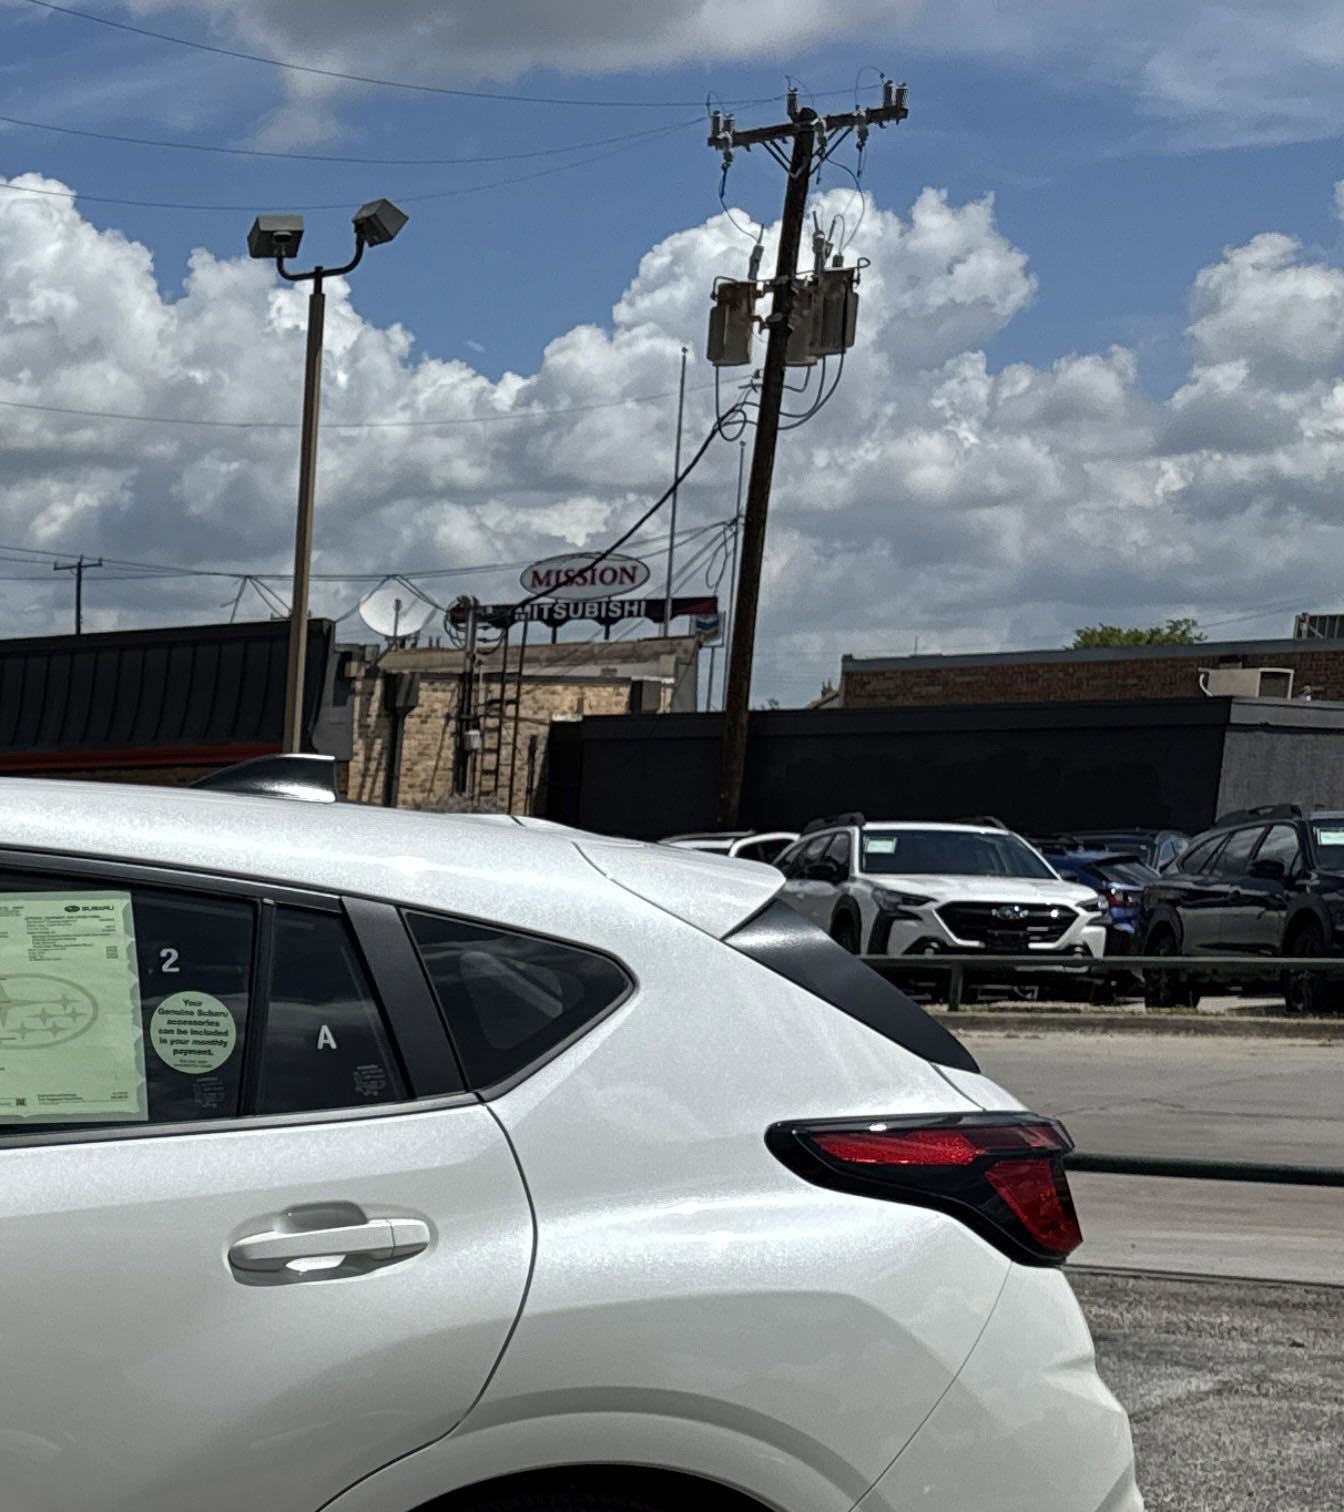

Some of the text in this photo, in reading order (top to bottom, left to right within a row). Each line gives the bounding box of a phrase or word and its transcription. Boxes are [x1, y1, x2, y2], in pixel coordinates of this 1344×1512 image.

[531, 565, 638, 589] MISSION
[514, 600, 647, 621] MITSUBISHI
[159, 948, 181, 973] 2
[167, 1019, 220, 1027] accessories
[317, 1025, 337, 1049] A
